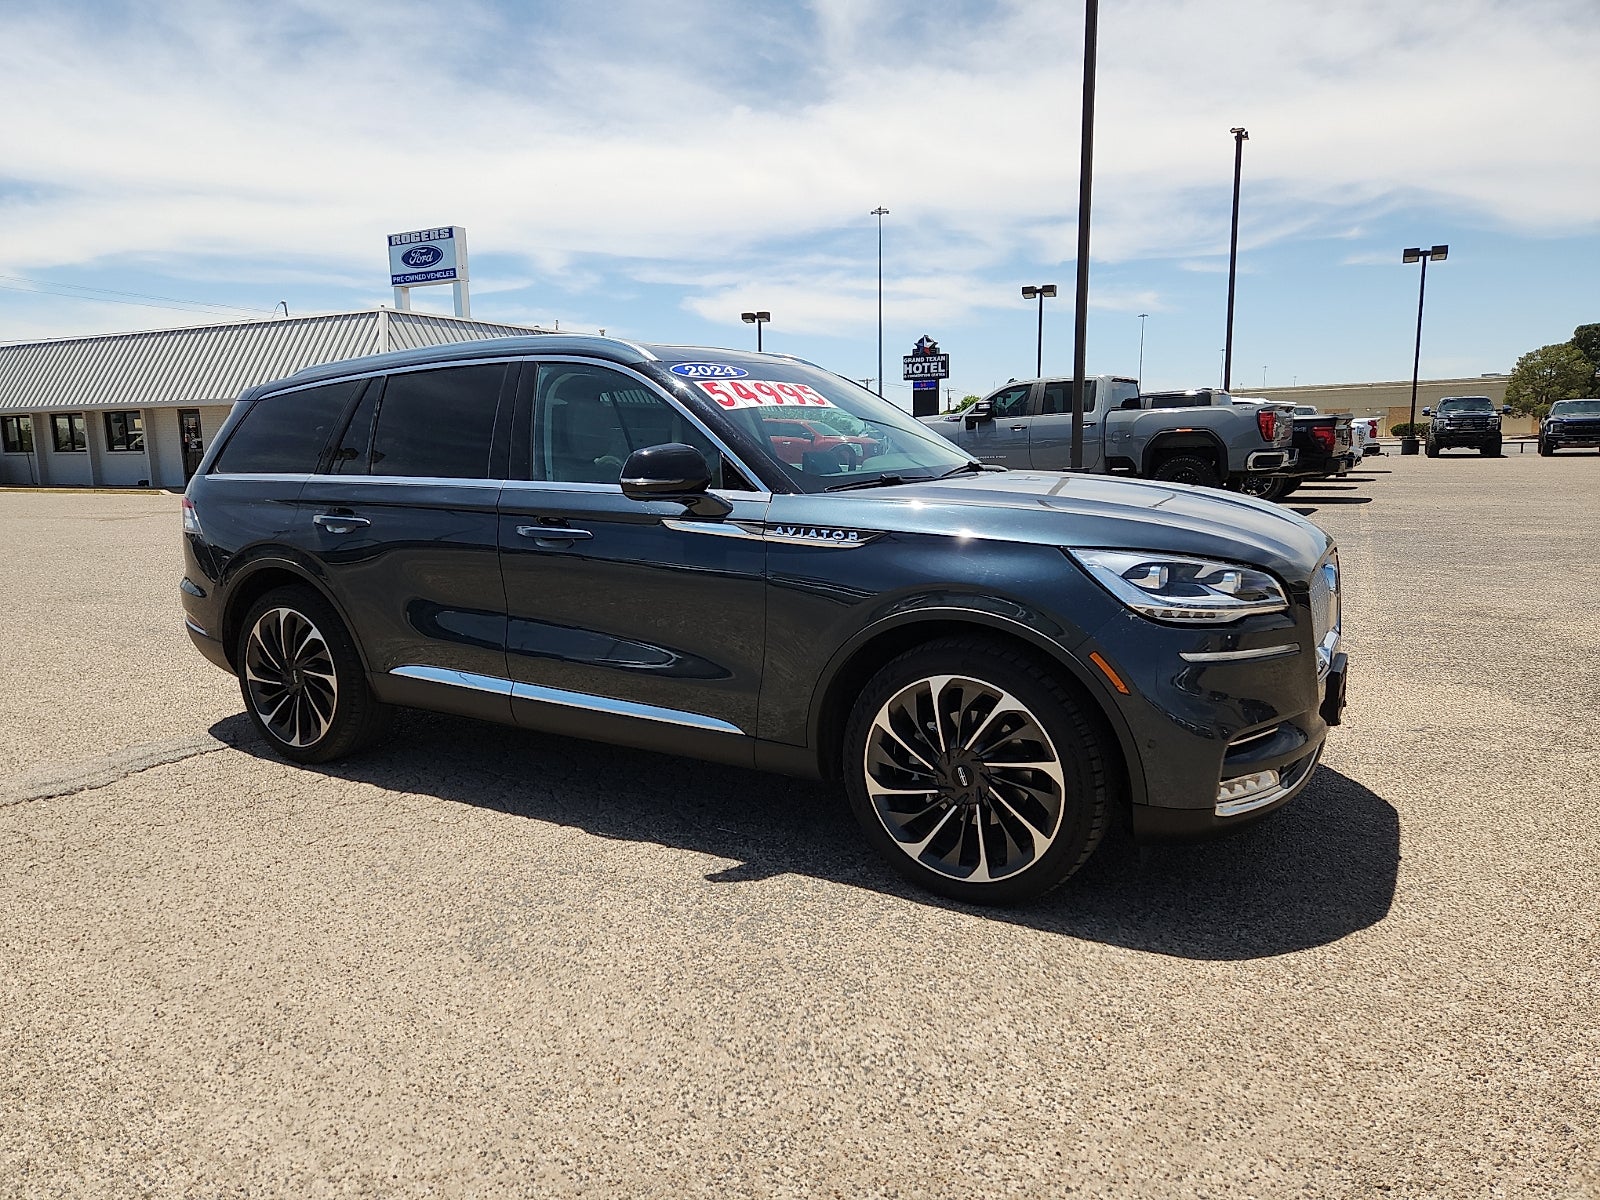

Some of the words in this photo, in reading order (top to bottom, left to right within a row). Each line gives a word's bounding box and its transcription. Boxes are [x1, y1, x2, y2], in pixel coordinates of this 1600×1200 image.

[391, 228, 450, 246] ROGERS
[409, 248, 434, 265] Ford
[393, 273, 427, 283] PRE-OWNED
[427, 270, 454, 279] VEHICLES
[684, 365, 738, 377] 2024
[903, 361, 946, 374] HOTEL
[701, 380, 826, 407] 54995
[775, 526, 859, 541] AVIATOR
